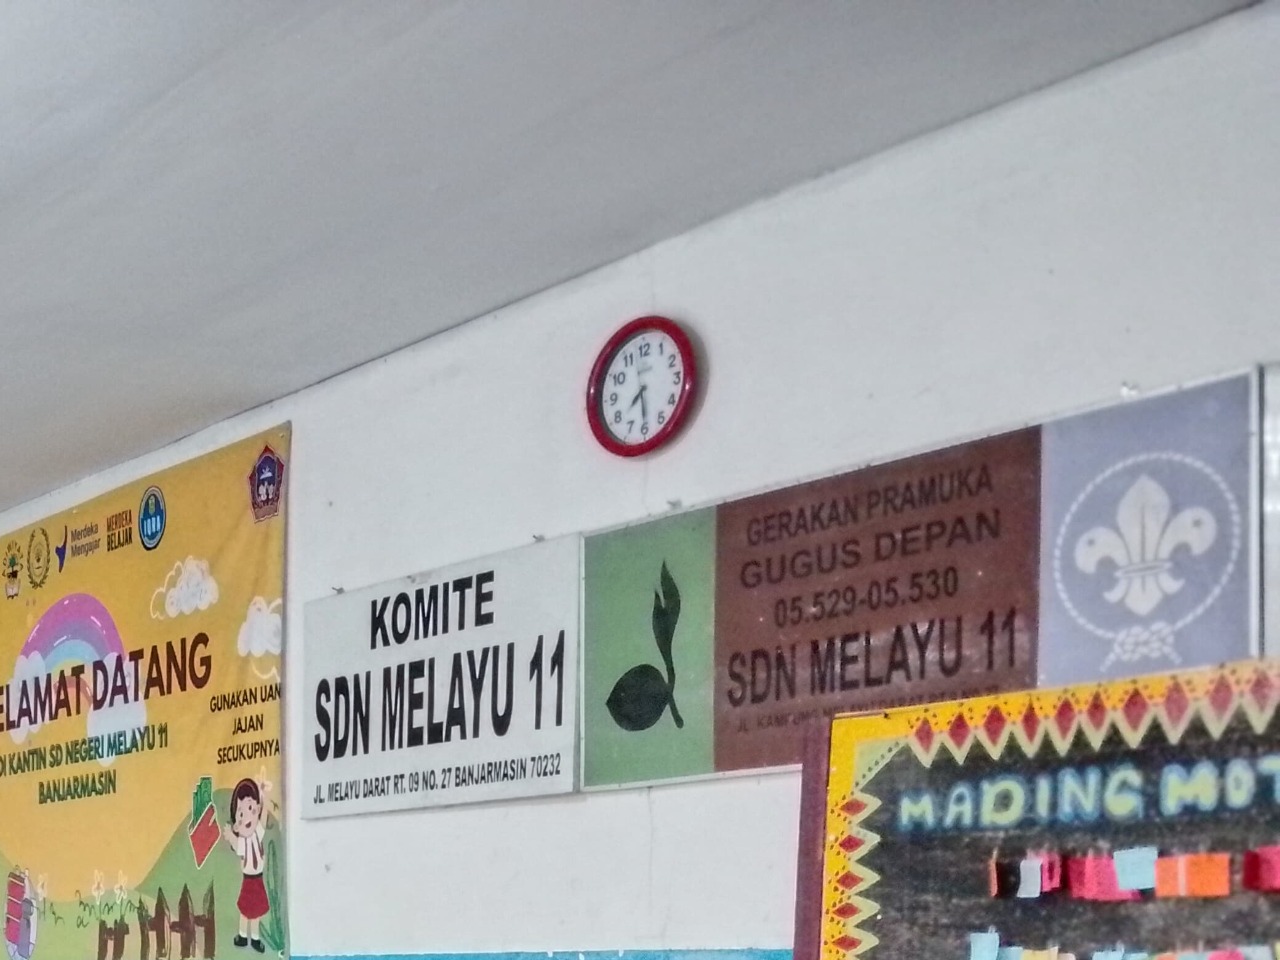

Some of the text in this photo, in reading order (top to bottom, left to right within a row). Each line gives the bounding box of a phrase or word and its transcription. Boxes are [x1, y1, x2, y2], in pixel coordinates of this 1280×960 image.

[638, 342, 651, 357] 12
[659, 342, 664, 356] 1
[624, 354, 634, 368] 11
[668, 354, 676, 368] 2
[613, 372, 626, 386] 10
[673, 371, 681, 385] 3
[610, 392, 618, 406] 9
[668, 393, 676, 406] 4
[614, 410, 622, 423] 8
[627, 420, 635, 434] 7
[657, 411, 665, 425] 5
[641, 422, 649, 435] 6
[746, 463, 992, 546] GERAKAN PRAMUKA
[71, 522, 99, 542] Merdeka
[107, 509, 133, 533] MERDEKA
[107, 527, 133, 552] BELAJAR
[740, 509, 1001, 589] GUGUS DEPAN
[370, 570, 495, 650] KOMITE
[727, 646, 797, 708] SDN
[810, 615, 963, 696] MELAYU
[980, 606, 1018, 671] 11
[92, 632, 212, 711] DATANG
[210, 687, 258, 713] GUNAKAN
[314, 629, 565, 762] SDN MELAYU 11
[232, 713, 264, 736] JAJAN
[8, 746, 47, 776] KANTIN
[49, 743, 63, 768] SD
[65, 737, 105, 764] NEGERI
[106, 725, 155, 760] MELAYU
[157, 722, 169, 750] 11
[217, 738, 281, 765] SECUKUPNYA
[38, 770, 117, 805] BANJARMASIN
[327, 779, 361, 802] MELAYU
[363, 776, 391, 798] DARAT
[393, 773, 407, 795] RT.
[408, 771, 419, 793] 09
[421, 769, 438, 792] NO.
[441, 767, 452, 790] 27
[454, 757, 527, 788] BANJARMASIN
[530, 752, 561, 779] 70232
[899, 763, 1144, 832] MADING
